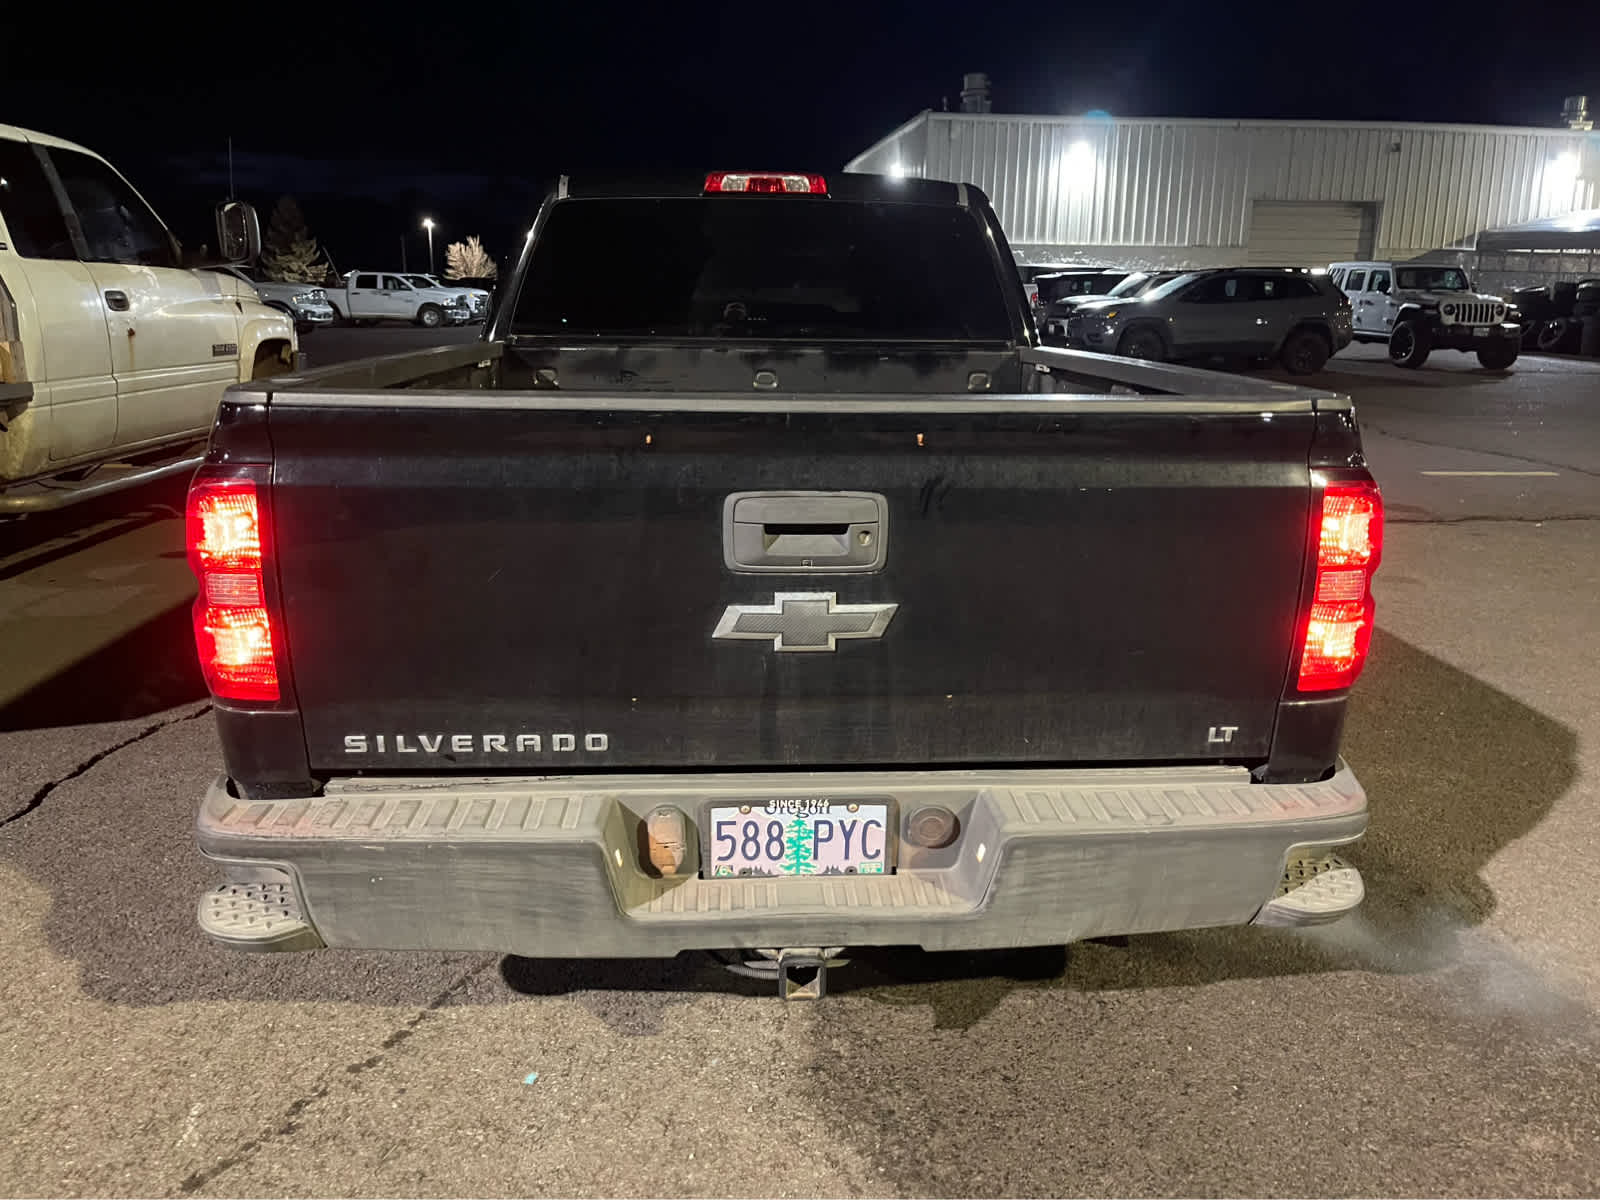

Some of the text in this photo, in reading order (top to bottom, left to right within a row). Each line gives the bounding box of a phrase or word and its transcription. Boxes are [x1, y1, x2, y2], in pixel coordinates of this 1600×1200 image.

[344, 733, 609, 753] SILVERADO
[1208, 726, 1239, 743] LT
[769, 799, 830, 809] SINCE 1946
[716, 819, 882, 861] 588 PYC
